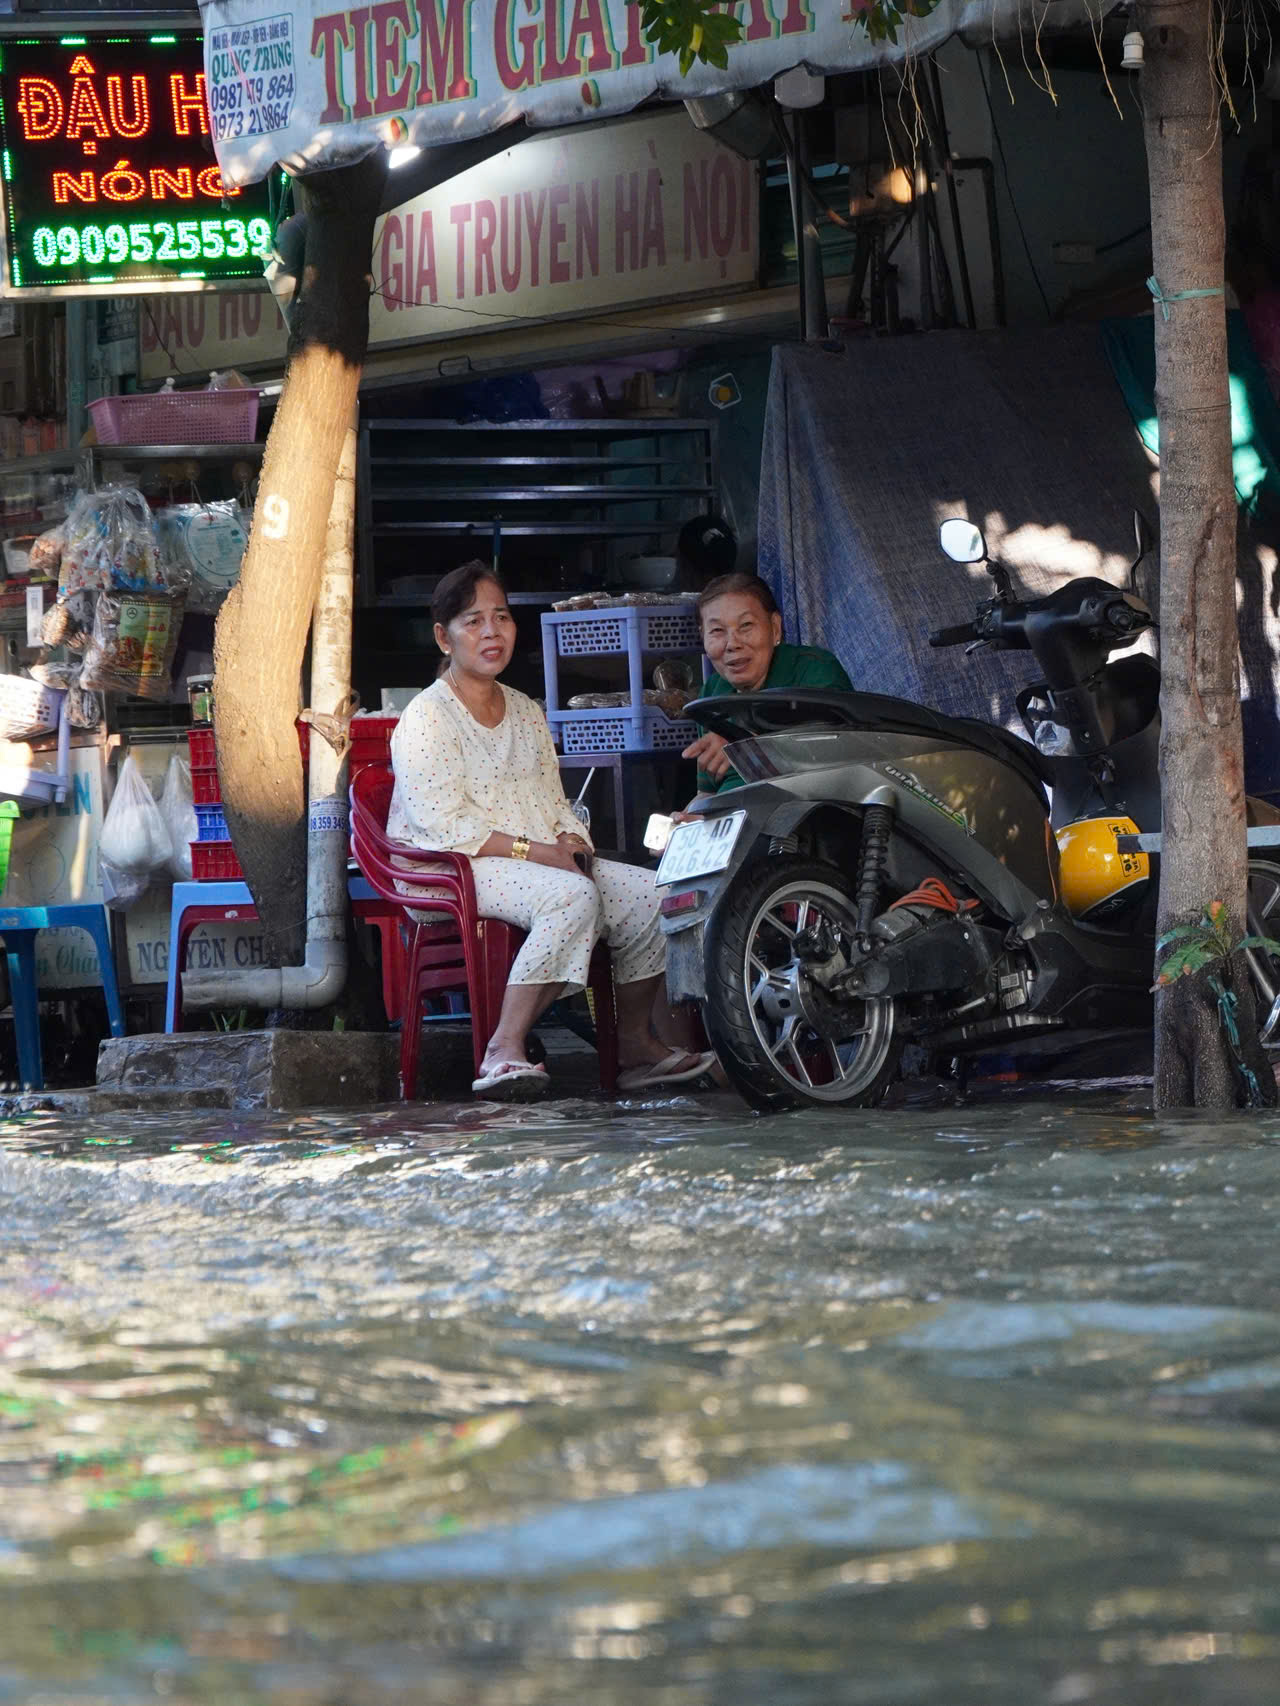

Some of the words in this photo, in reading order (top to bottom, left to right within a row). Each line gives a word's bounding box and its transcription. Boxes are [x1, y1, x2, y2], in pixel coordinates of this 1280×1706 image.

[212, 49, 250, 85] QUANG
[253, 41, 292, 72] TRUNG
[18, 56, 150, 154] ĐẬU
[211, 82, 243, 112] 0987
[266, 73, 294, 101] 864
[212, 110, 244, 140] 0973
[53, 160, 241, 203] NÓNG
[33, 218, 272, 267] 0909525539
[381, 210, 438, 313] GIA
[450, 140, 599, 300] TRUYỀN
[615, 140, 666, 275] HÀ
[263, 495, 289, 538] 9
[137, 930, 226, 972] NGYÊN
